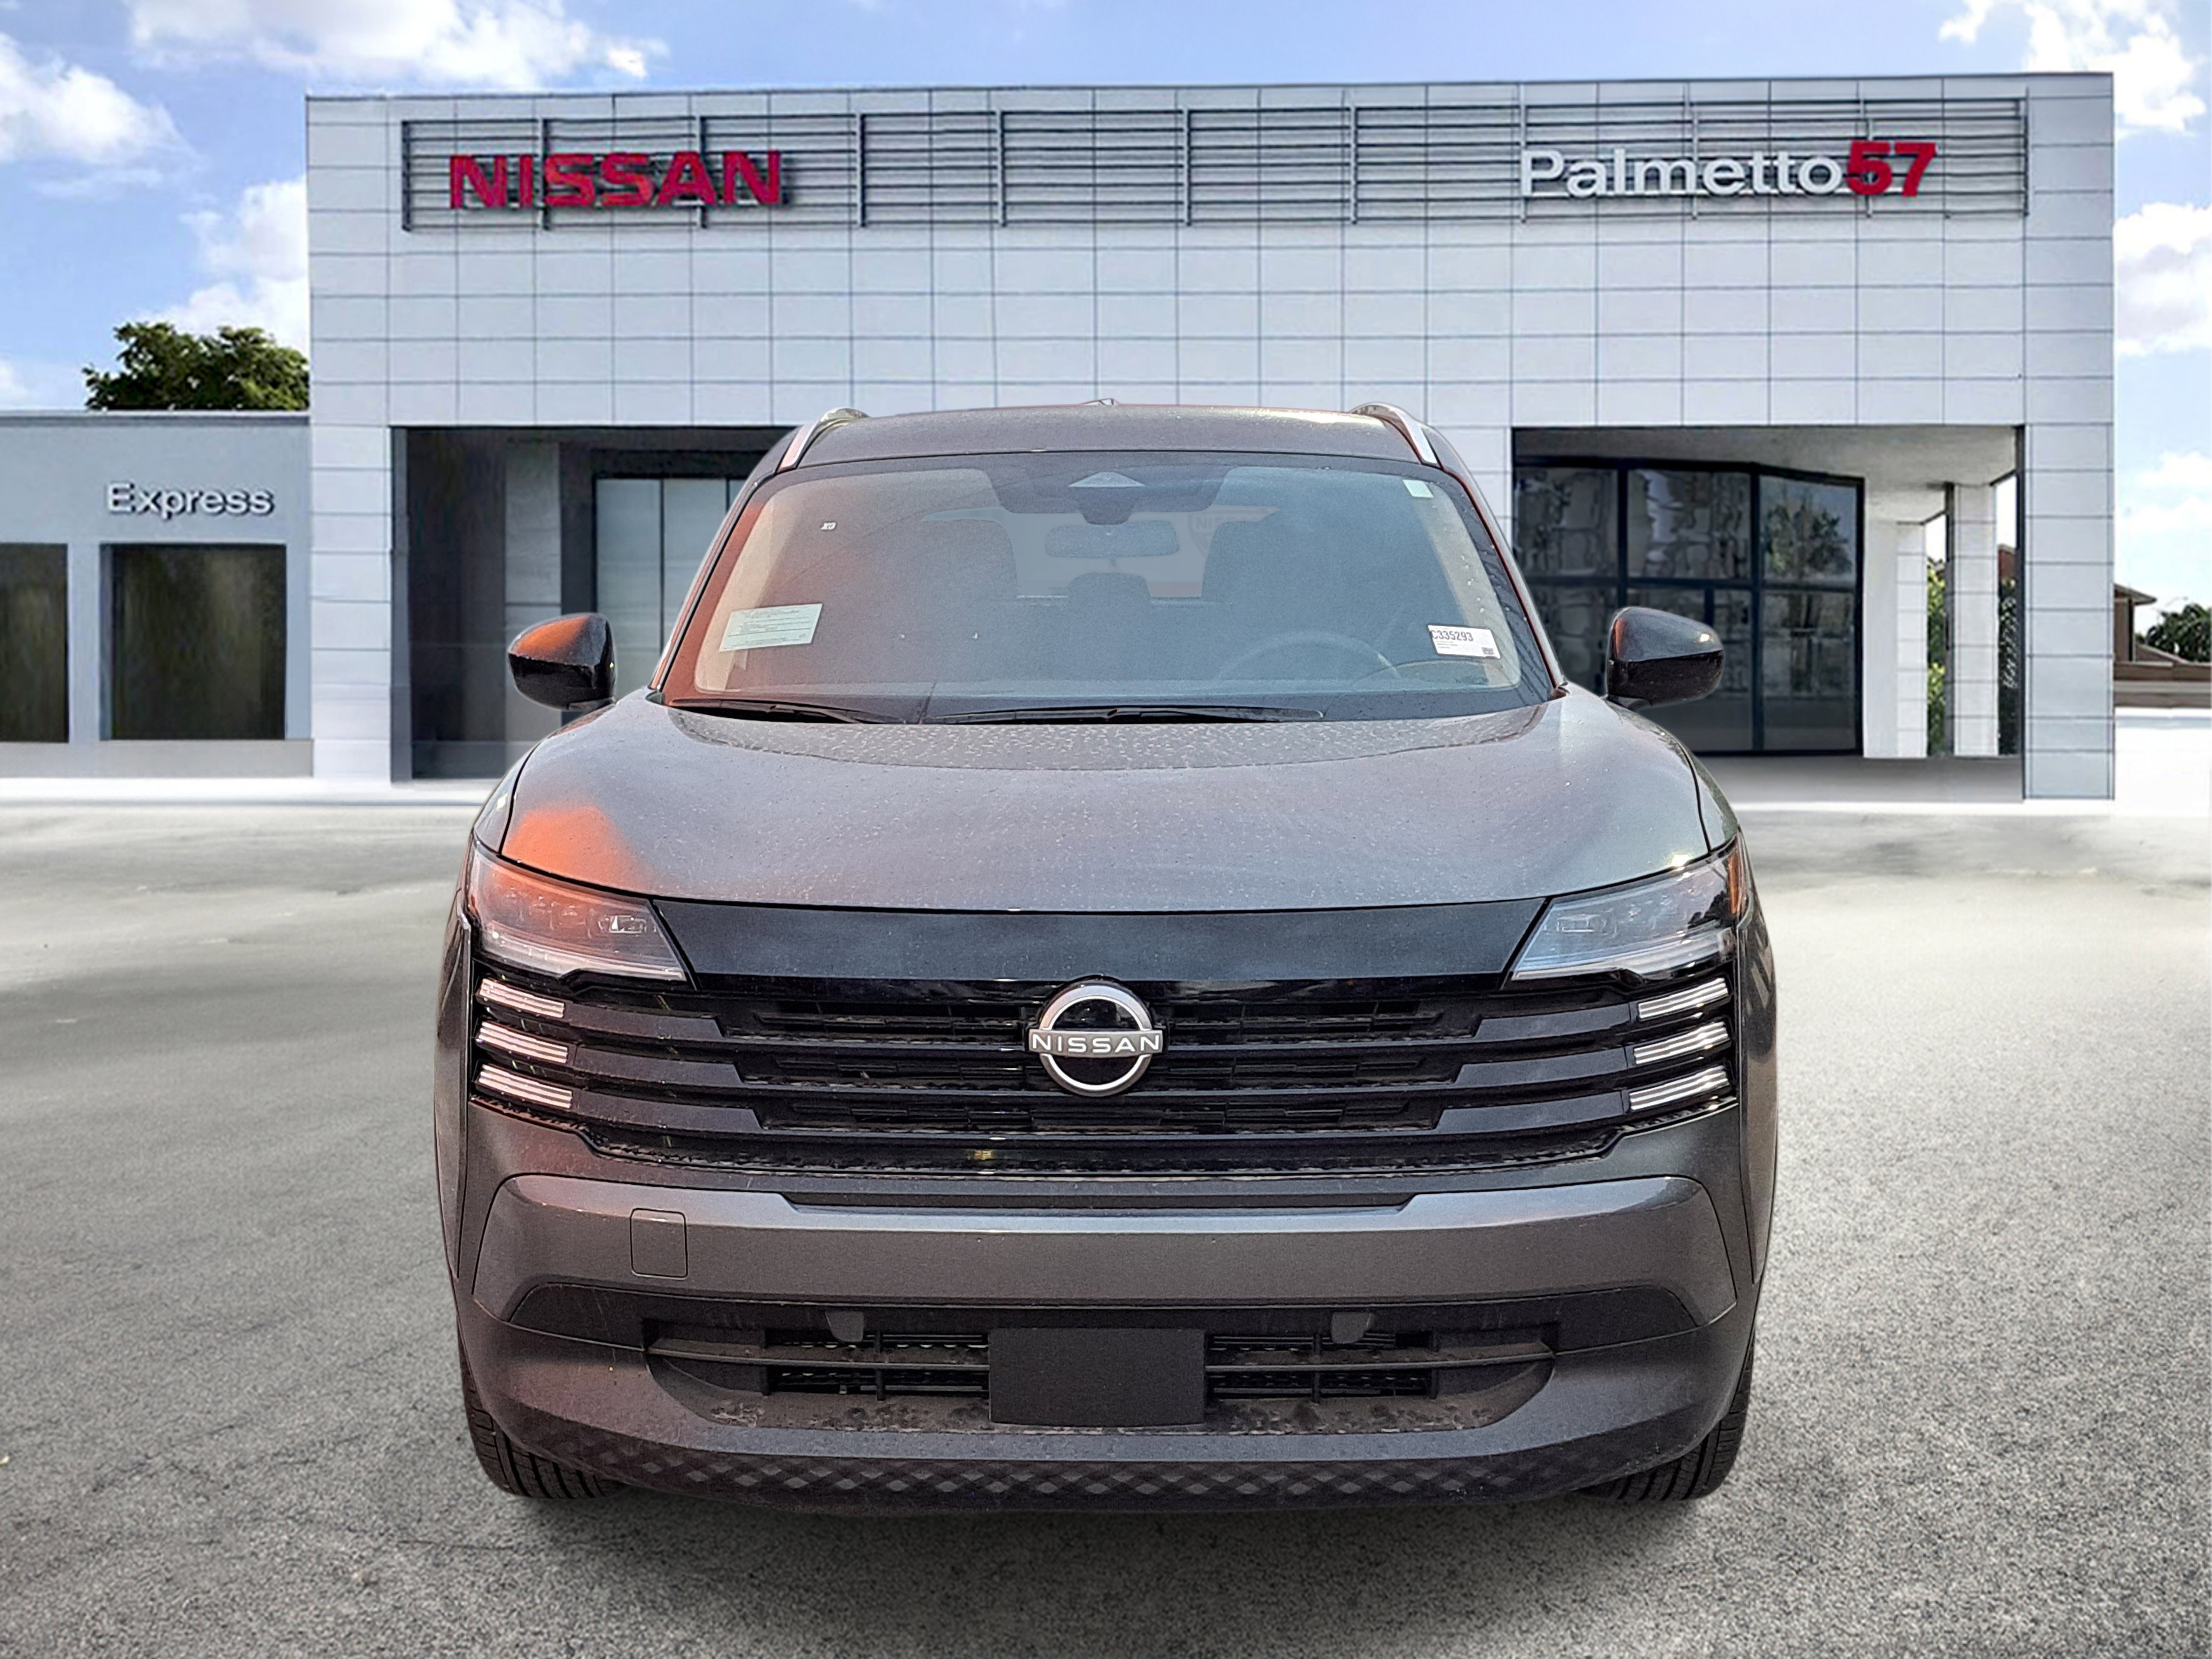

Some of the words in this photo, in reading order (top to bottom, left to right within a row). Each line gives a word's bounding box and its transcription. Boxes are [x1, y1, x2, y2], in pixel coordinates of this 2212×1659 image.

[449, 150, 782, 210] NISSAN
[108, 482, 275, 520] Express
[1032, 1033, 1160, 1053] NISSAN
